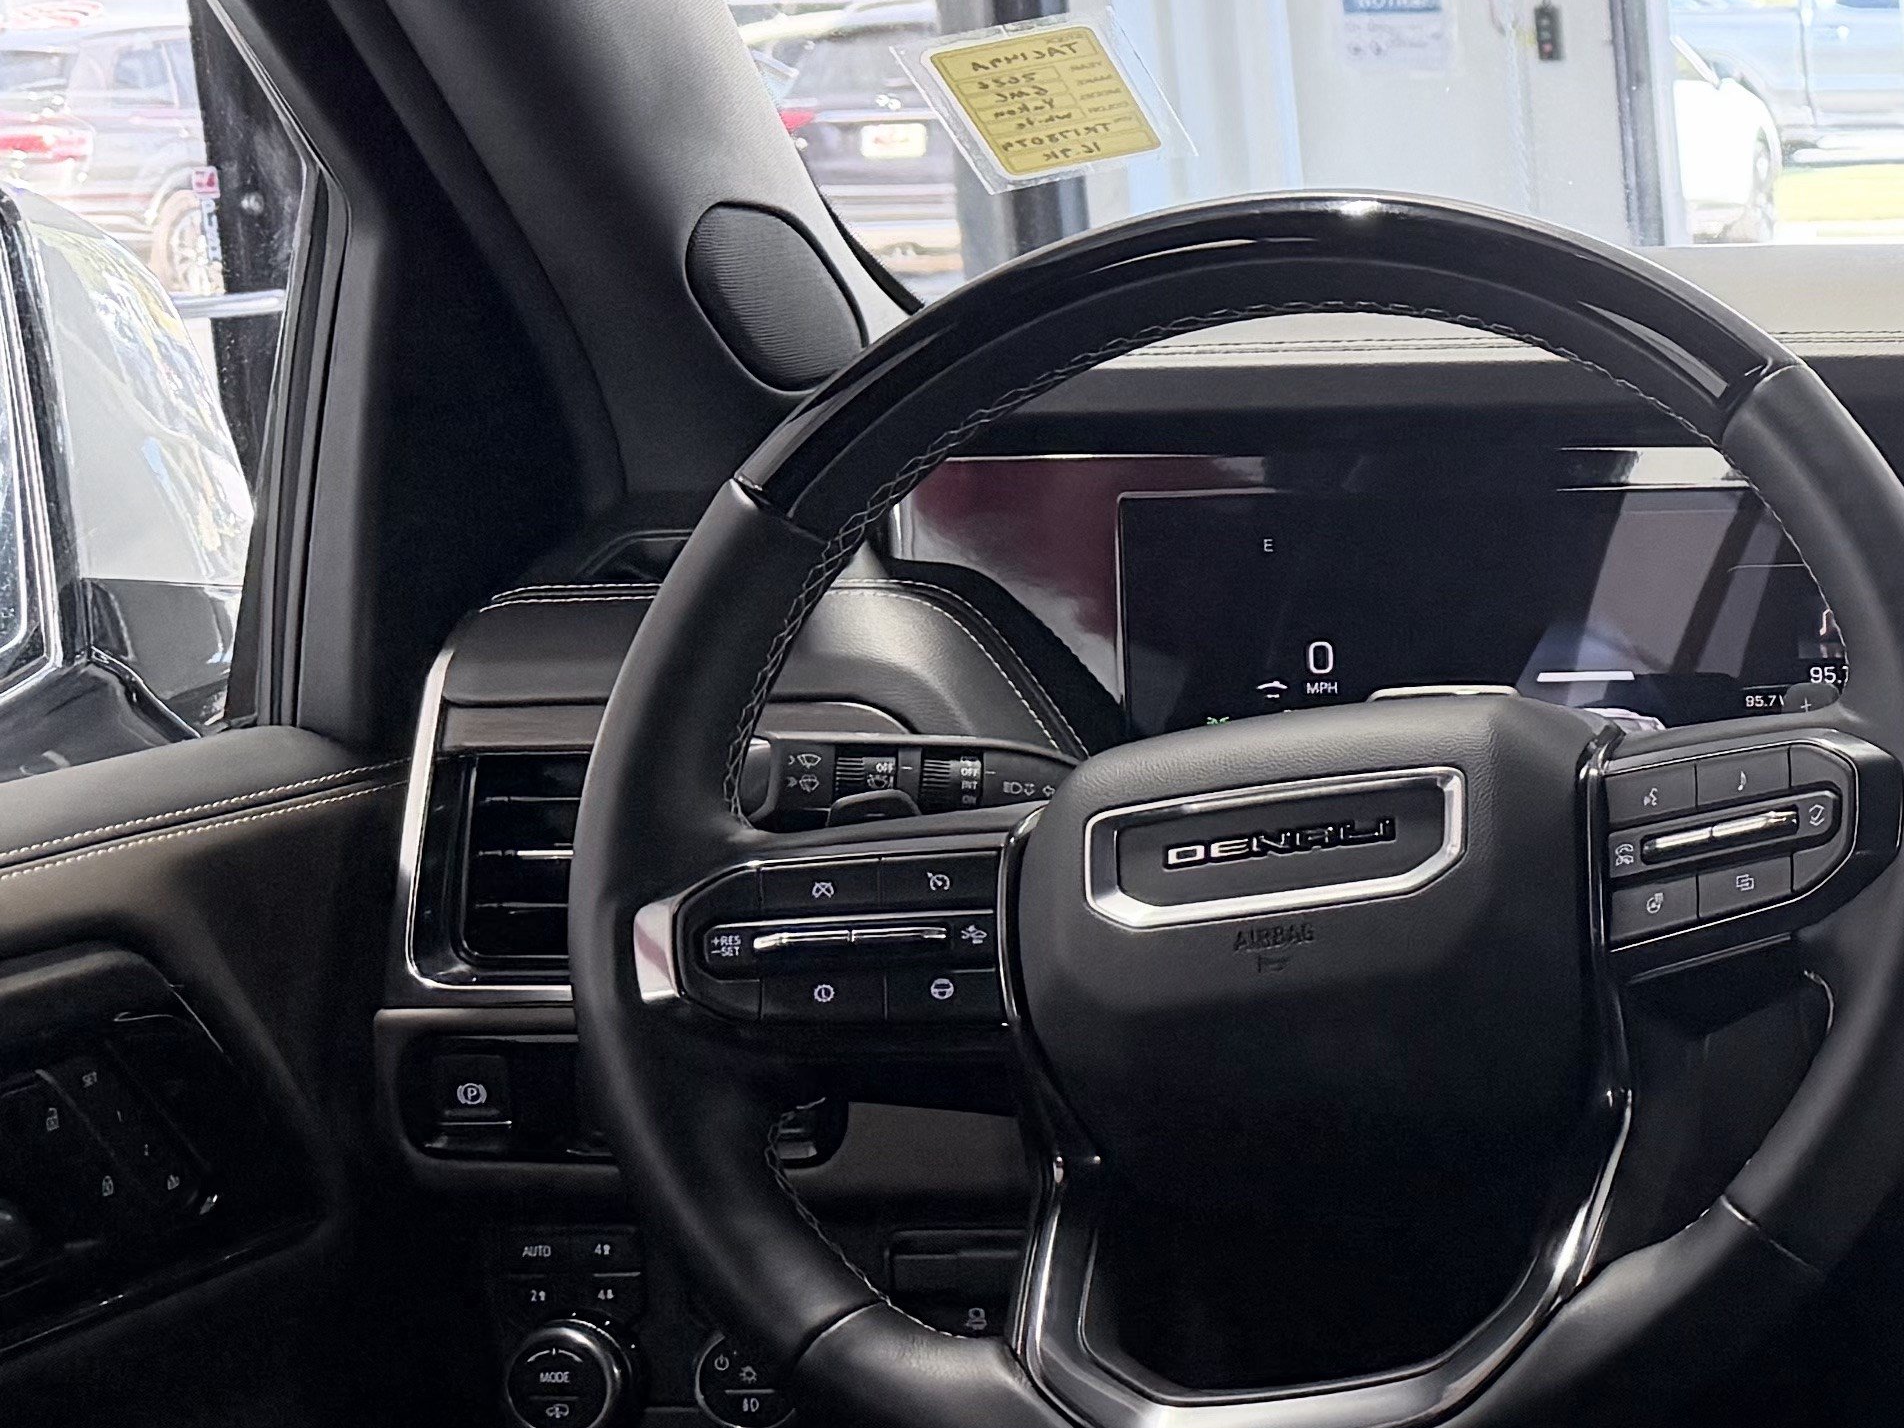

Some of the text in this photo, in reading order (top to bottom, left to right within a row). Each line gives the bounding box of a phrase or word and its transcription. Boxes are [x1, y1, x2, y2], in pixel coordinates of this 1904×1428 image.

[1307, 641, 1334, 674] 0
[1306, 682, 1338, 695] MPH
[1165, 818, 1394, 867] DENALI
[1233, 923, 1315, 951] AIRBAG
[522, 1244, 552, 1258] AUTO
[539, 1371, 570, 1383] MODE
